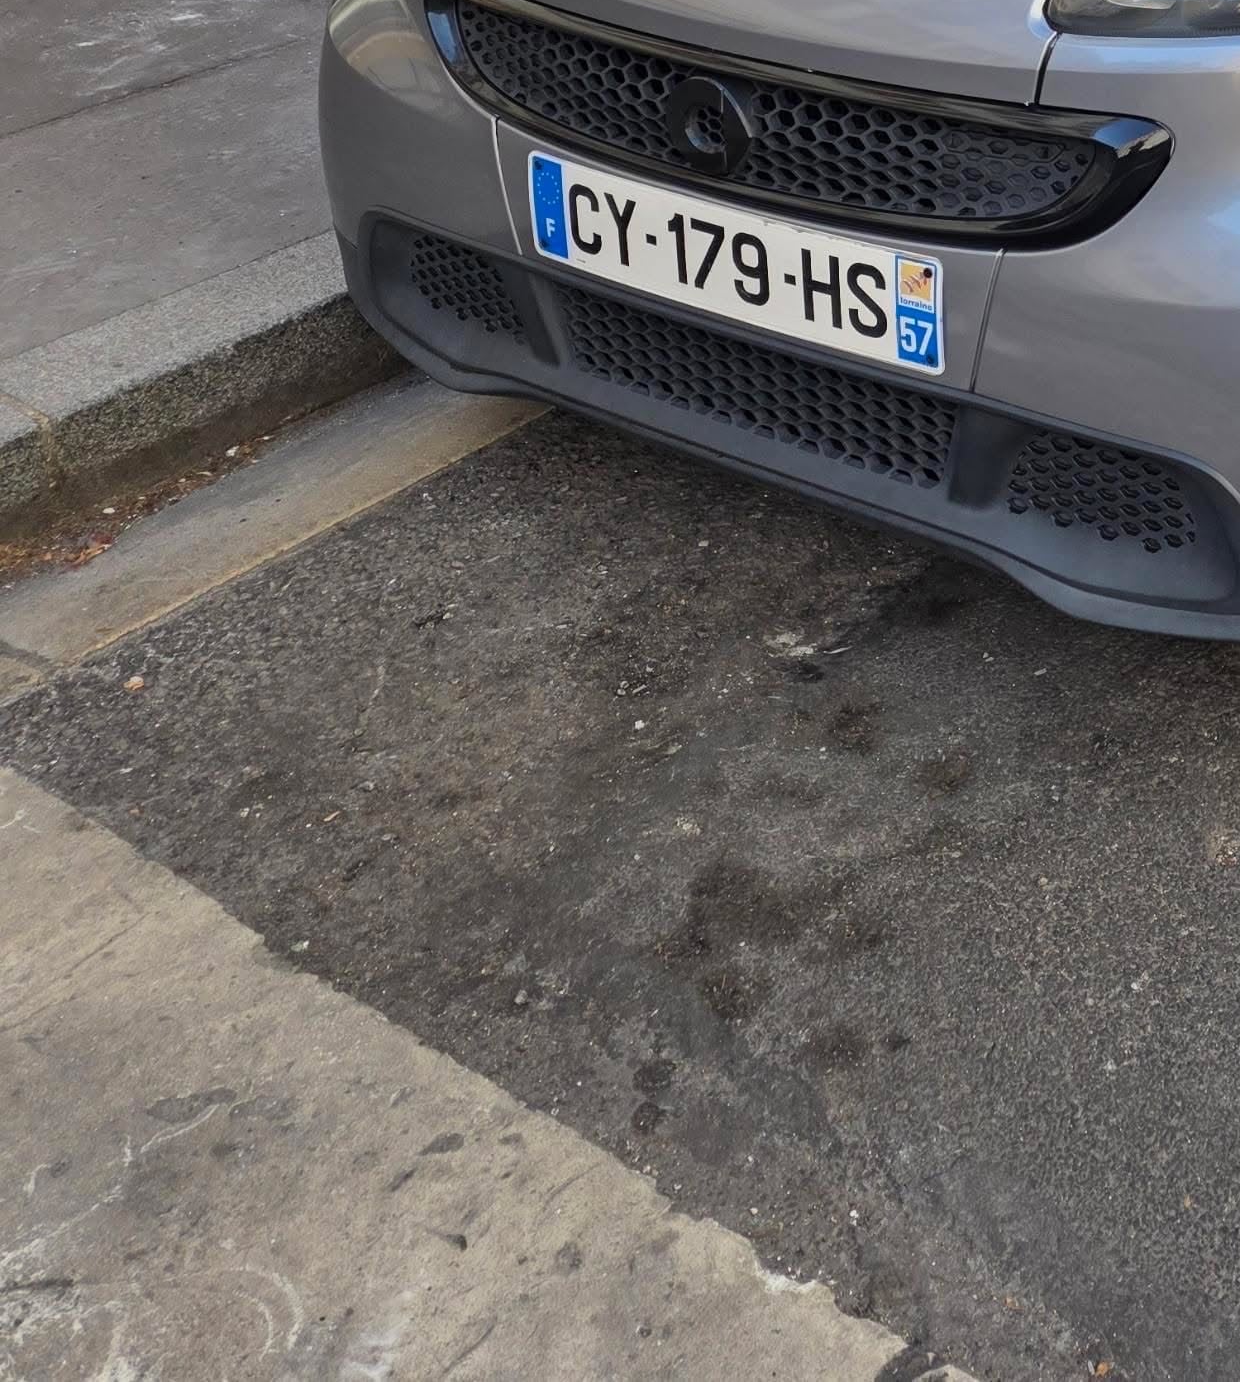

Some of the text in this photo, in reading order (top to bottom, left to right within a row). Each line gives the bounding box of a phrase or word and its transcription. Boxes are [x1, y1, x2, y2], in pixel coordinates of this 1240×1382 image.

[546, 217, 556, 238] F
[568, 183, 888, 339] CY-179-HS
[900, 316, 934, 356] 57
